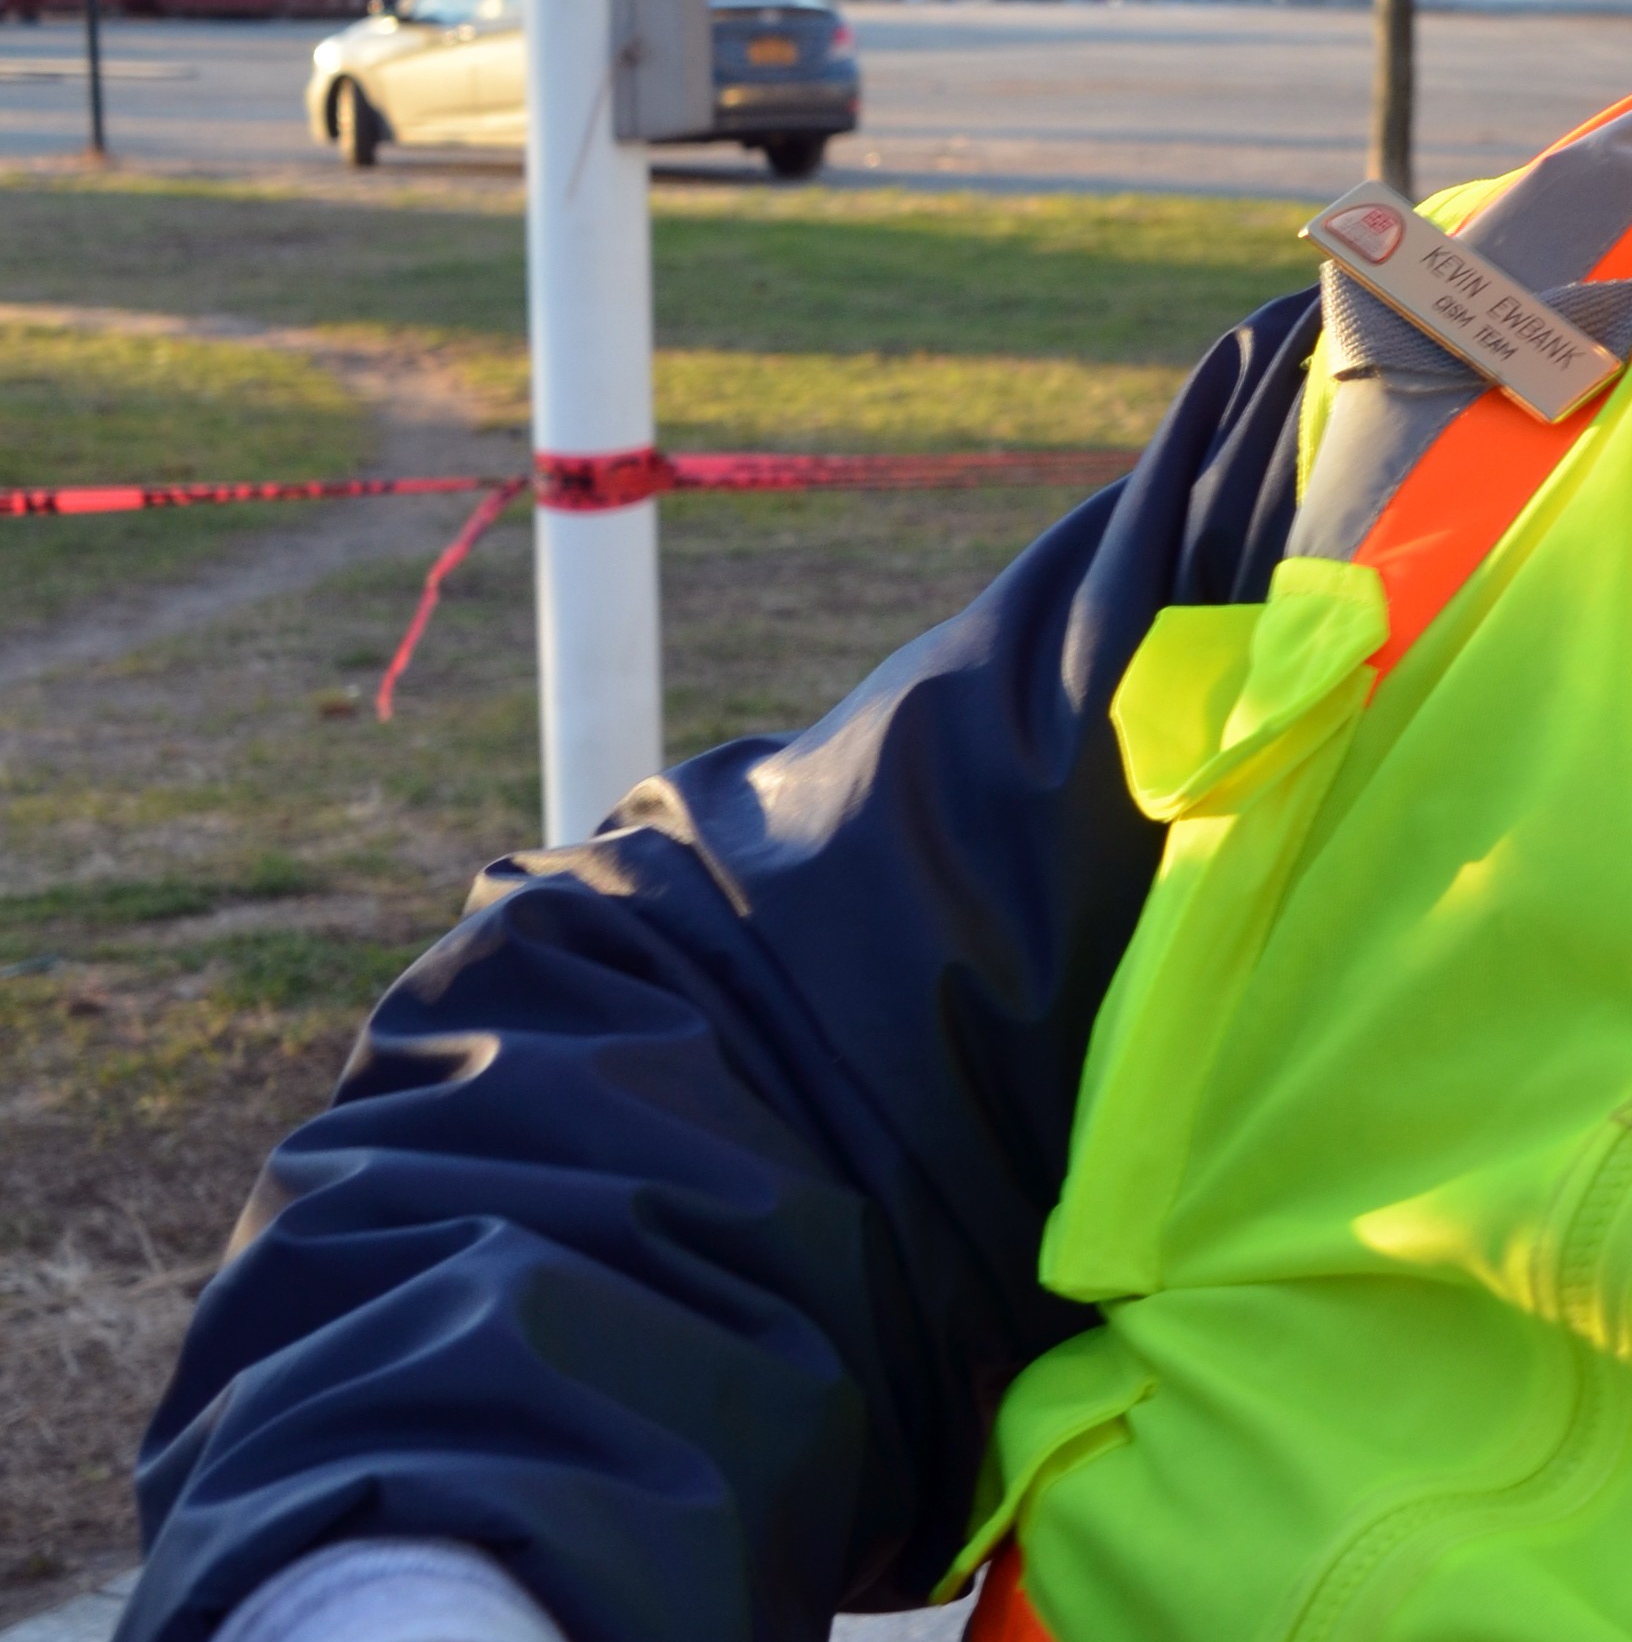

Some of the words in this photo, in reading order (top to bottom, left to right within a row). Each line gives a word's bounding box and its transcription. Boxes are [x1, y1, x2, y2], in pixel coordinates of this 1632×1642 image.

[1420, 246, 1492, 298] KEVIN
[1487, 296, 1586, 372] EWBANK
[1474, 325, 1519, 361] TEAM
